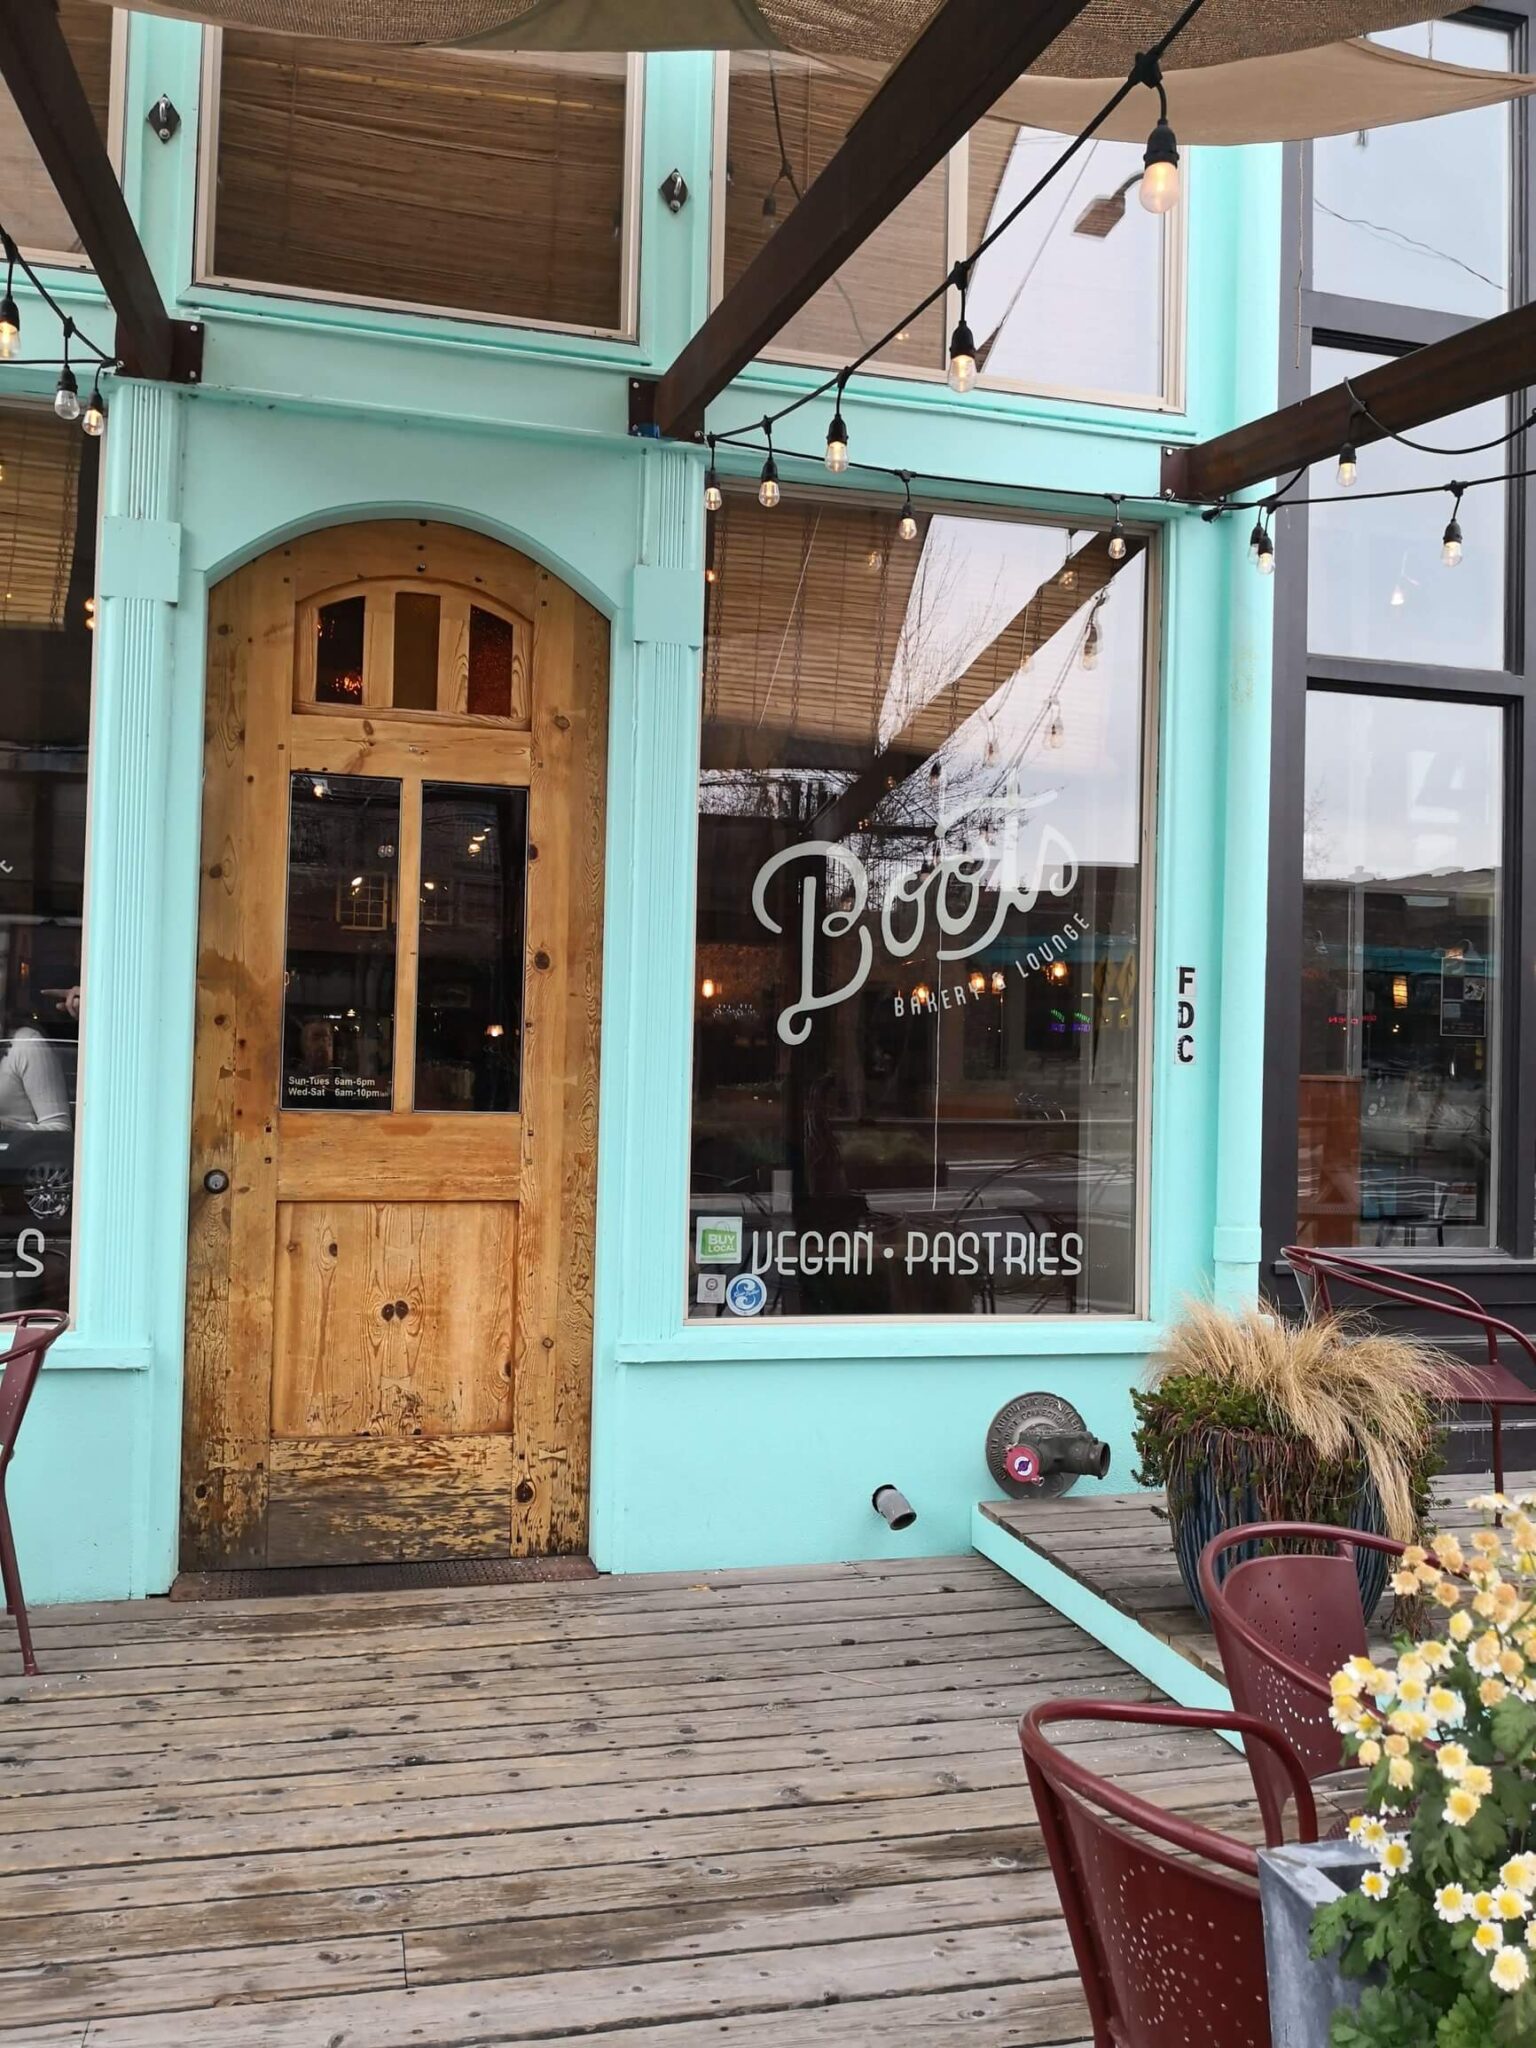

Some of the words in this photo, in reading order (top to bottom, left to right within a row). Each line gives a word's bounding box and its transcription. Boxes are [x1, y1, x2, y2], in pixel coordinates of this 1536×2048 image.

[752, 791, 1078, 1045] Boots
[894, 982, 980, 1017] BAKERY
[1015, 912, 1090, 978] LOUNGE
[1177, 966, 1195, 1062] FDC
[288, 1076, 330, 1086] Sun-Tues
[334, 1077, 376, 1087] 6am-6pm
[288, 1087, 325, 1096] Wed-Sat
[708, 1234, 735, 1244] BUY
[708, 1244, 735, 1253] LOCAL
[752, 1231, 873, 1275] VEGAN
[904, 1231, 1083, 1276] PASTRIES
[995, 1397, 1038, 1433] AUTOMATIC
